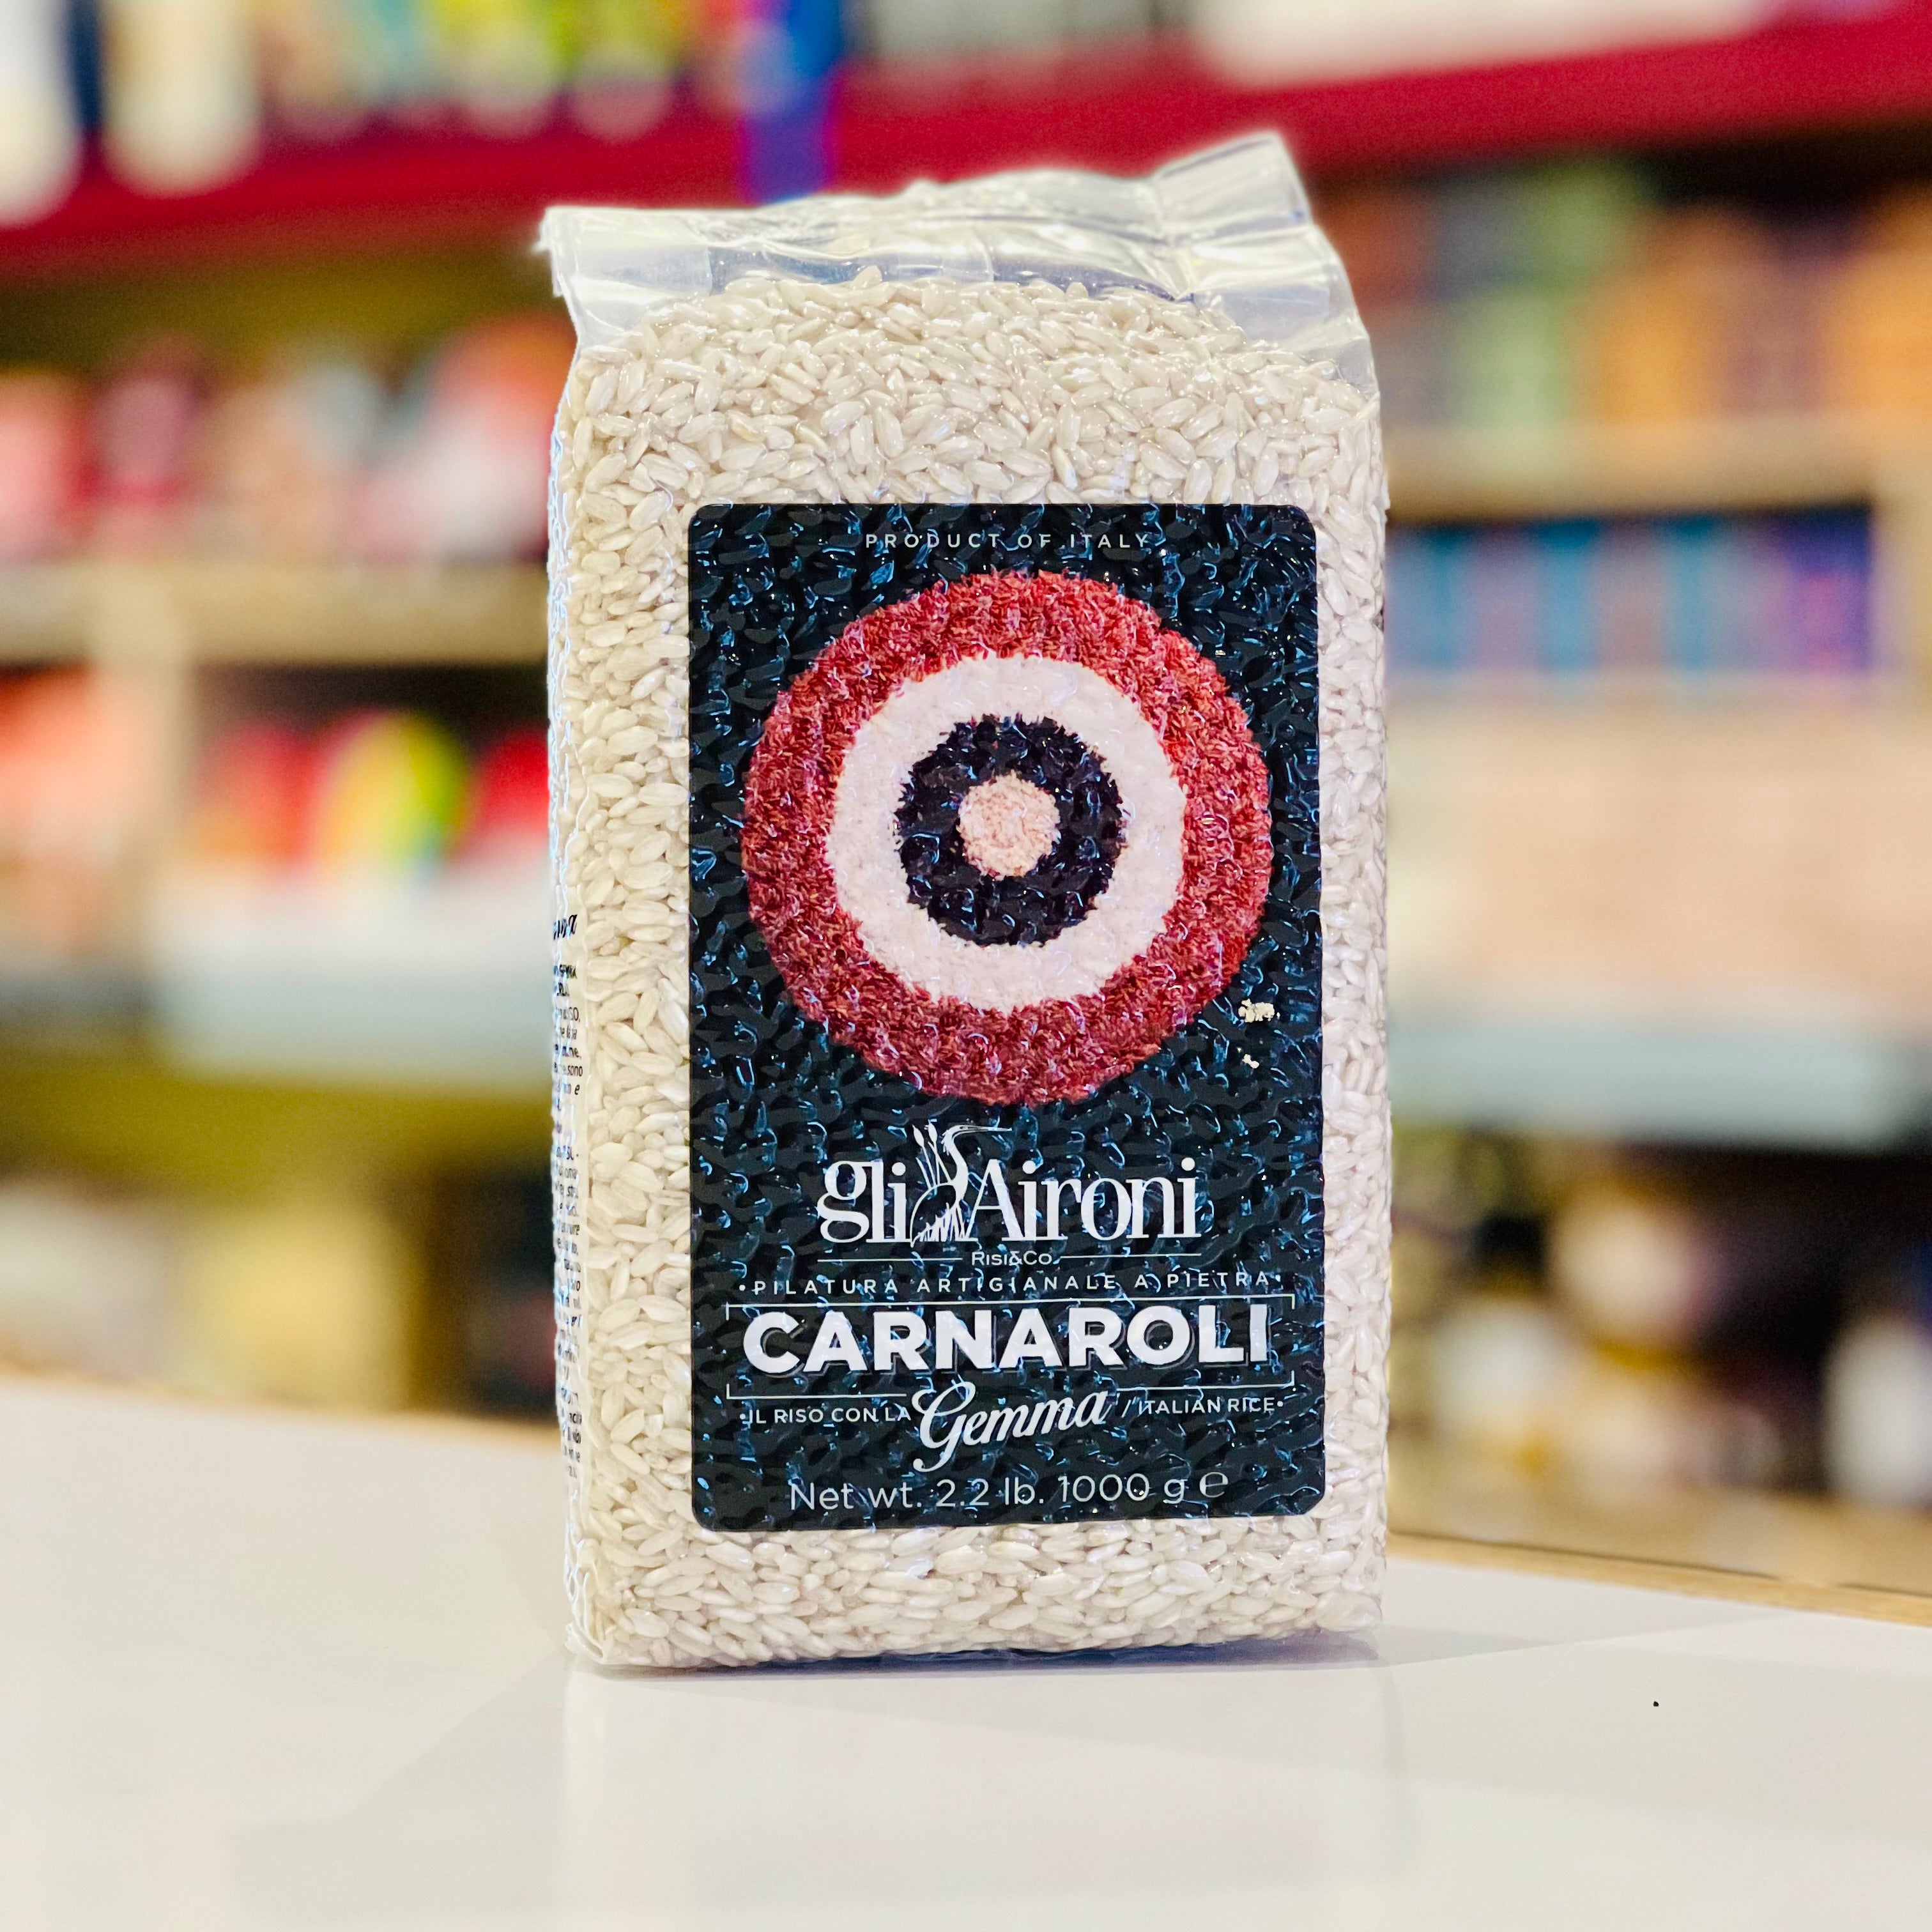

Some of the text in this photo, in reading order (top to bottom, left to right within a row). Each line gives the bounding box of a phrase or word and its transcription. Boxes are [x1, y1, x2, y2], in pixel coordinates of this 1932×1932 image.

[866, 533, 1149, 548] PRODUCT OF ITALY
[818, 1157, 1202, 1243] gli Aironi
[754, 1271, 1269, 1295] PILATURA ARTIGIANALE A PIETRA
[742, 1303, 1269, 1374] CARNAROLI
[749, 1409, 767, 1423] IL
[774, 1408, 824, 1423] RISO
[831, 1407, 877, 1423] CON
[885, 1407, 912, 1422] LA
[911, 1383, 1112, 1472] Gemma
[1138, 1399, 1220, 1414] ITALIAN
[1228, 1397, 1275, 1413] RICE
[790, 1482, 854, 1510] Net
[868, 1482, 923, 1508] wt.
[935, 1478, 990, 1507] 2.2
[1004, 1476, 1044, 1505] lb.
[1057, 1473, 1150, 1503] 1000
[1163, 1478, 1186, 1505] g
